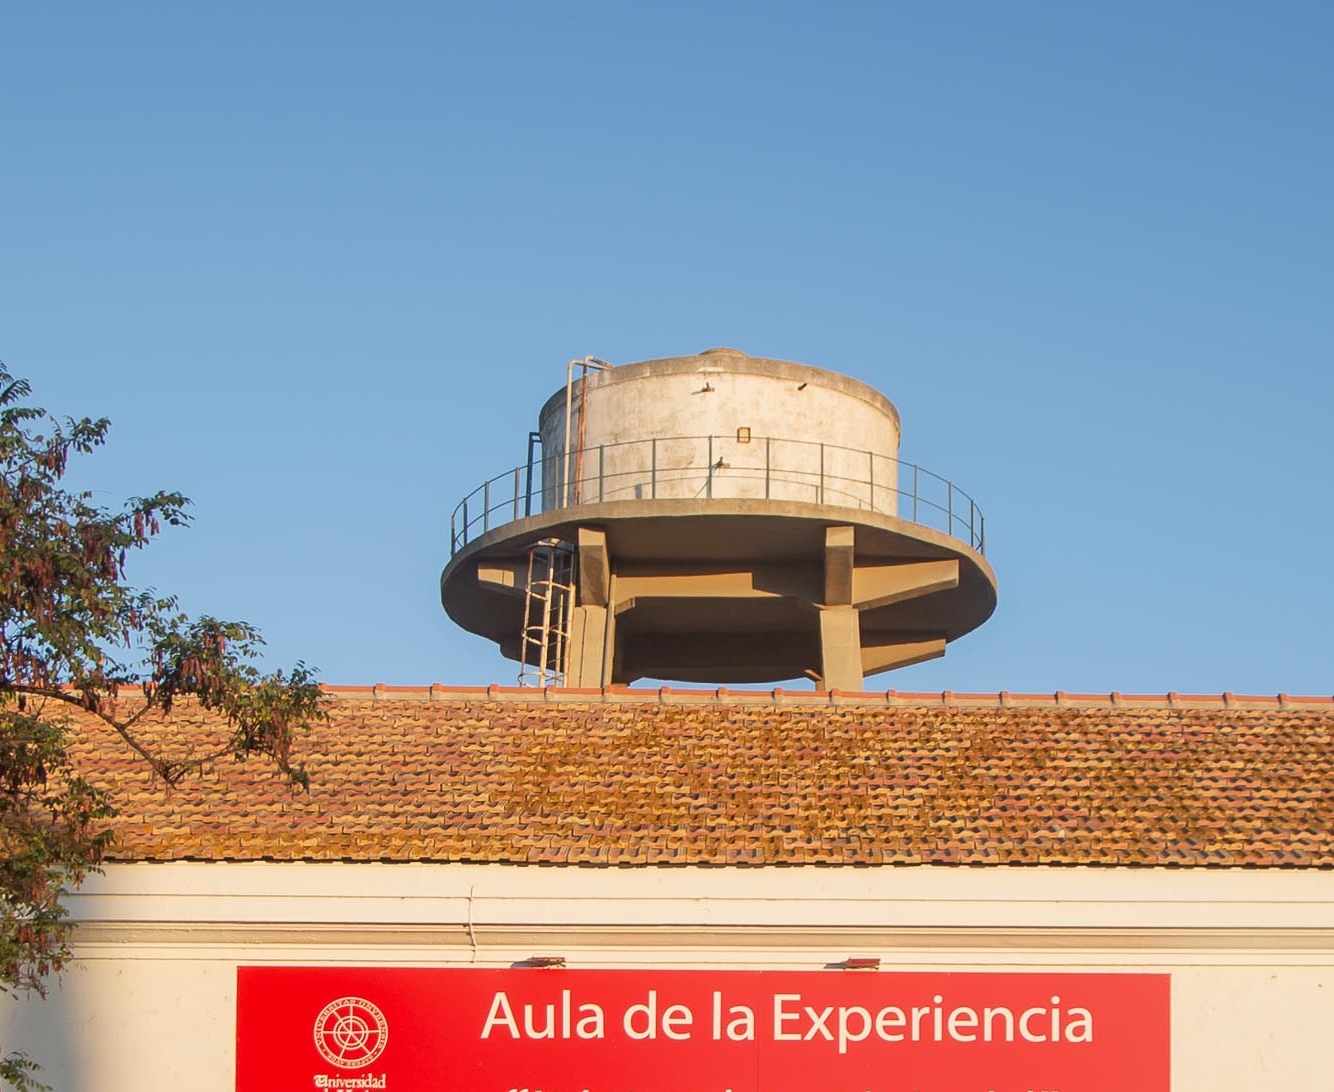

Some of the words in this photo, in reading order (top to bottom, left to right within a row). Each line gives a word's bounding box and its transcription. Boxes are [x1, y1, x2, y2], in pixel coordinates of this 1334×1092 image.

[480, 989, 605, 1041] Aula
[623, 990, 694, 1041] de
[712, 990, 755, 1041] la
[773, 993, 1093, 1054] Experiencia
[313, 1072, 386, 1089] Universidad
